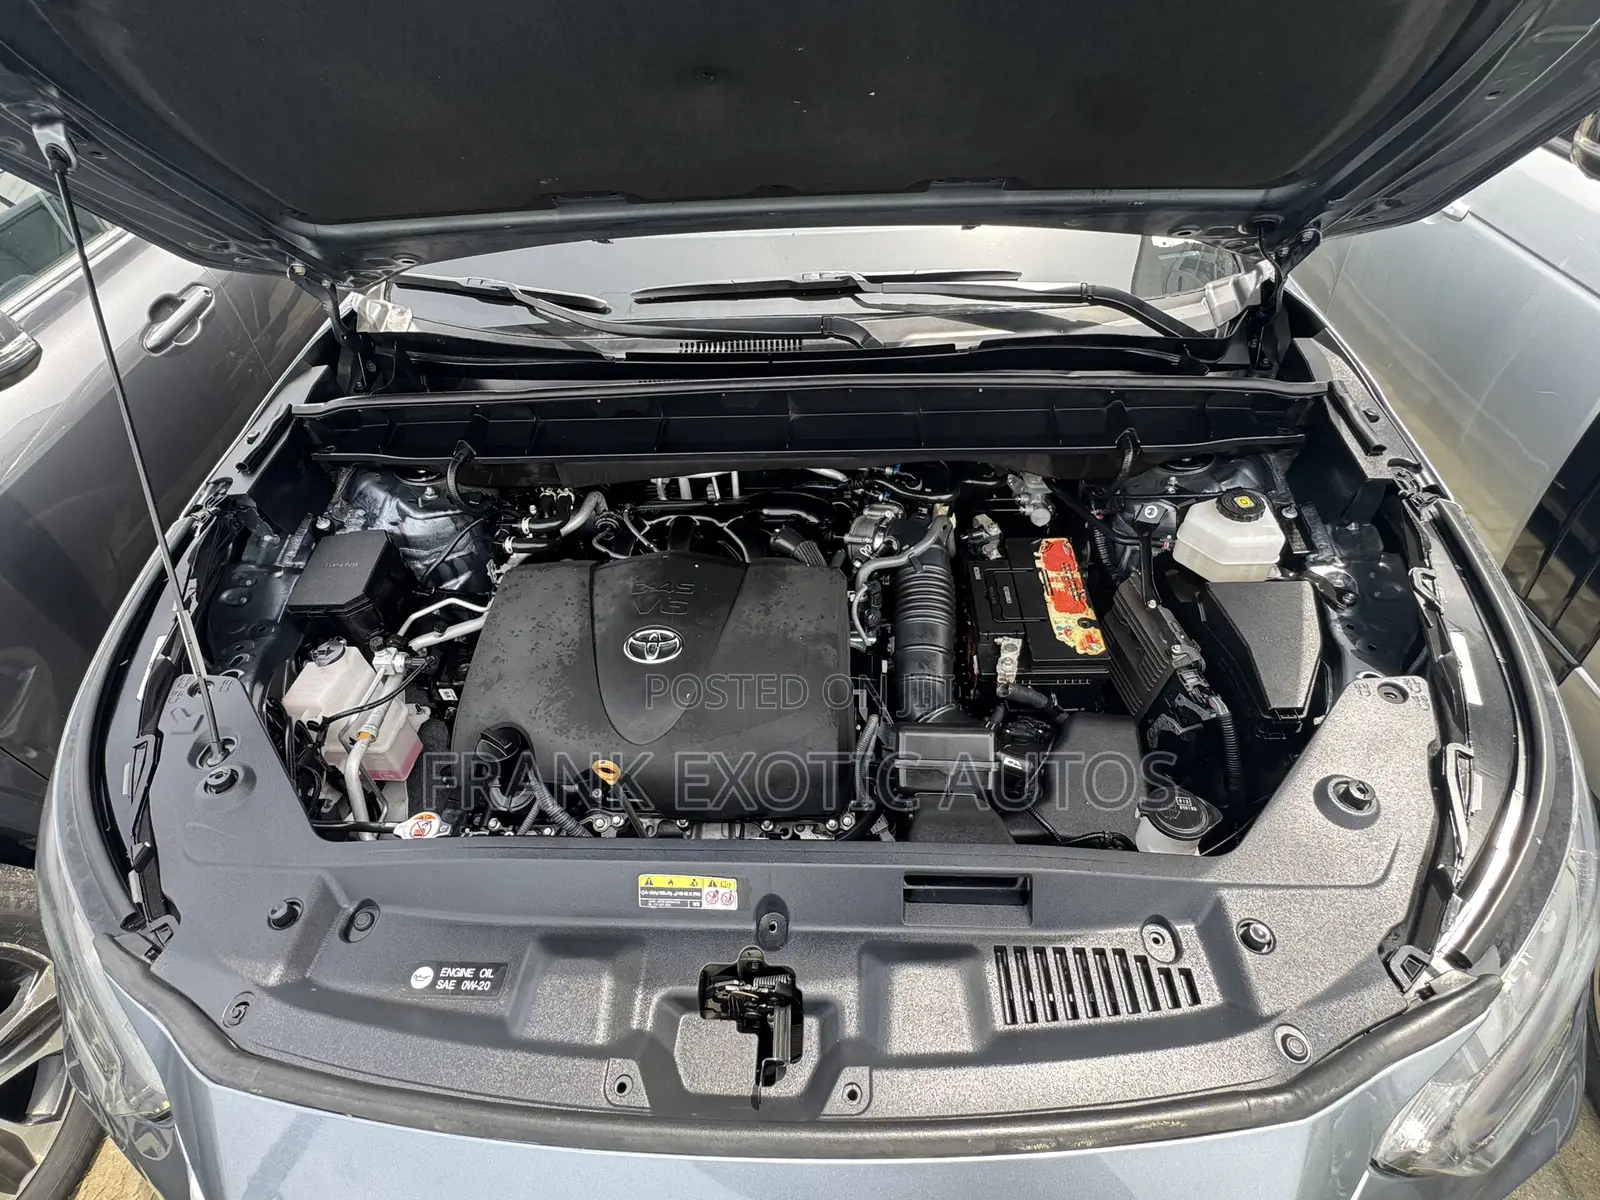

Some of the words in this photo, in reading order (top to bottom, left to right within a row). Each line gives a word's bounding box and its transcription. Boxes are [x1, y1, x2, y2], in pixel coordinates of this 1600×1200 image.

[439, 967, 476, 978] ENGINE
[479, 968, 494, 979] OIL
[435, 980, 457, 990] SAE
[461, 980, 491, 991] 0W-20
